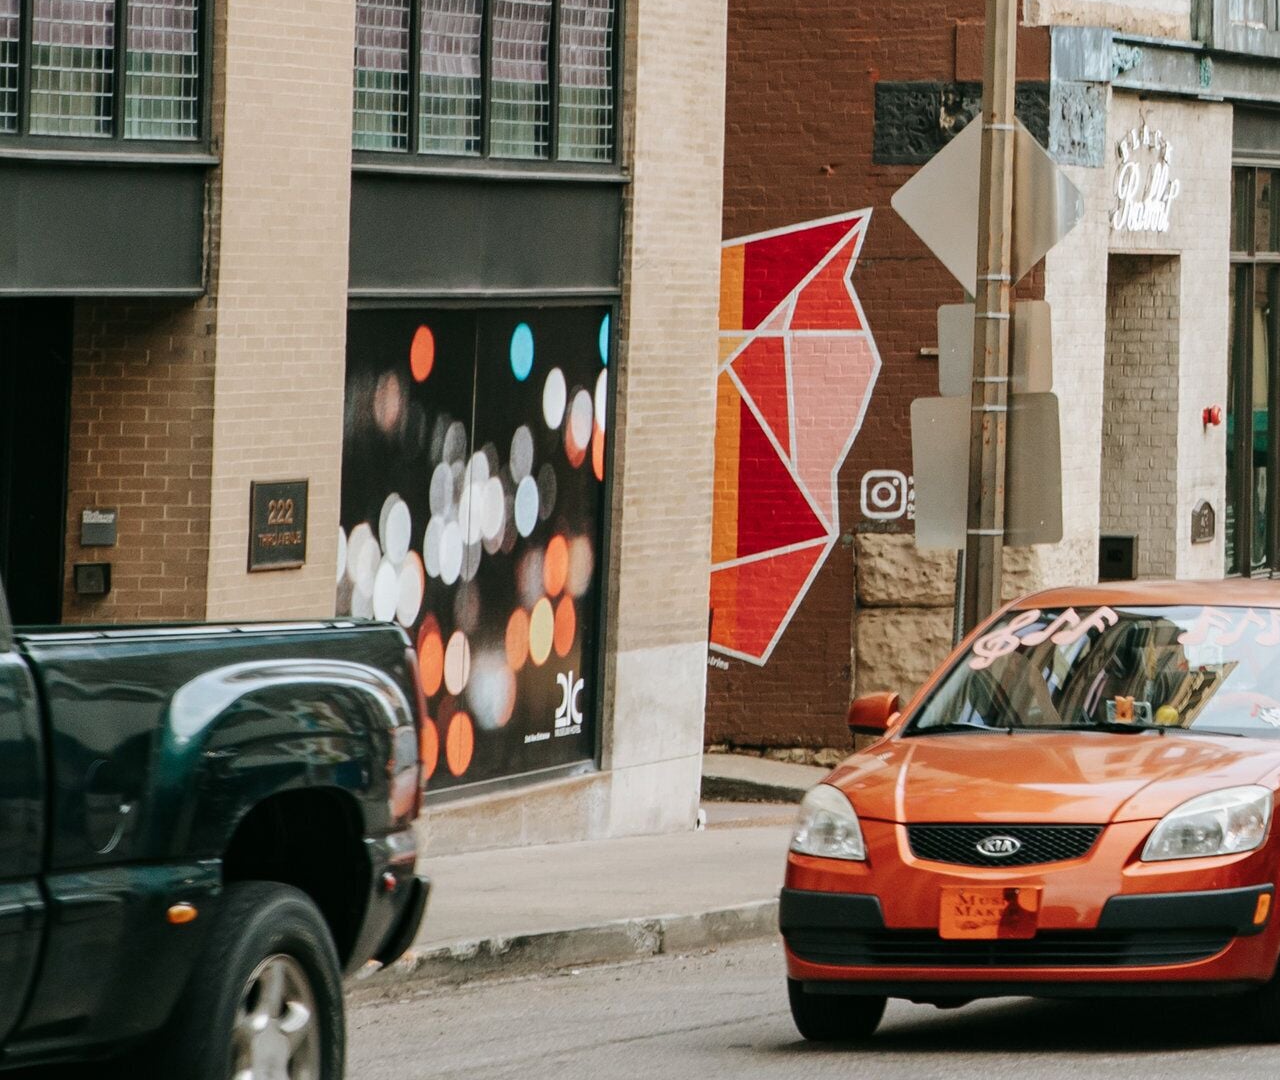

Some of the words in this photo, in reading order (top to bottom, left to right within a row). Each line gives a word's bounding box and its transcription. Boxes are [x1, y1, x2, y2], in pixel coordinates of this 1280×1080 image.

[1113, 161, 1180, 232] Rabbit
[268, 499, 293, 525] 222
[984, 840, 1013, 852] KIA
